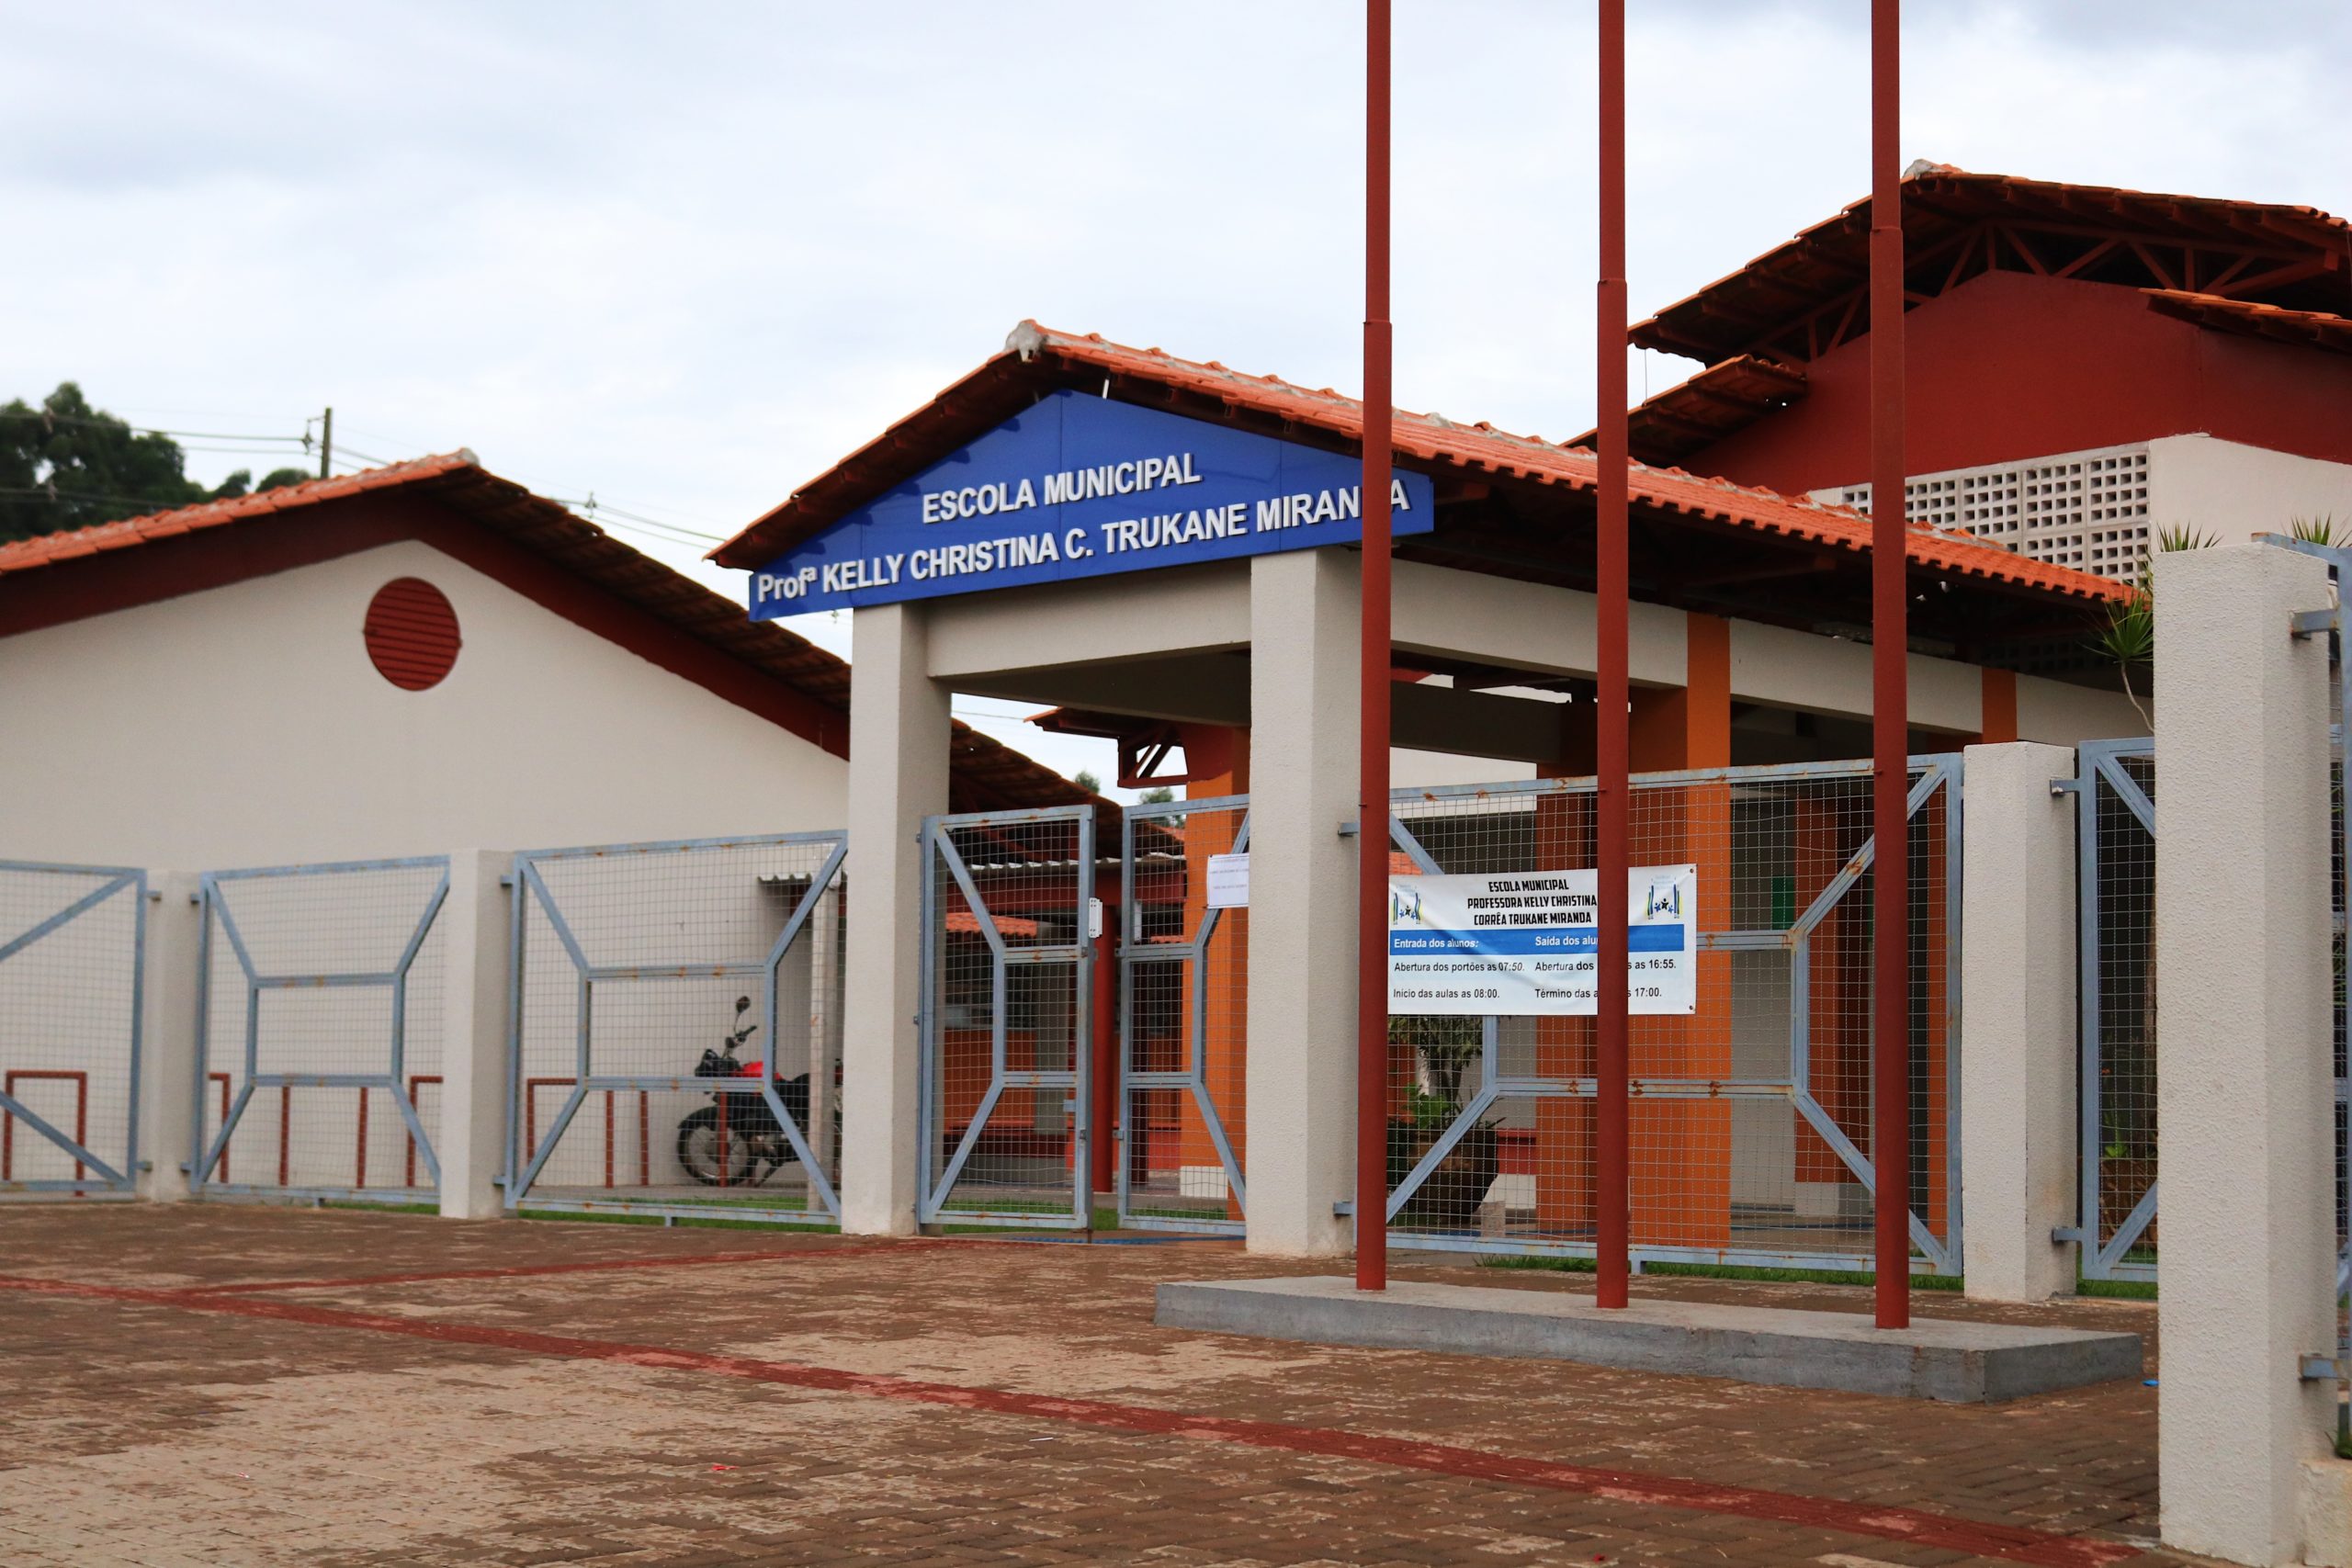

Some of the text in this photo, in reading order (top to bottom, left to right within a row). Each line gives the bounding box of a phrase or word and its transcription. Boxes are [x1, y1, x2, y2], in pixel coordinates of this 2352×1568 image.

[922, 453, 1202, 525] ESCOLA MUNICIPAL
[822, 553, 904, 593] KELLY
[910, 532, 1060, 581] CHRISTINA
[1065, 527, 1094, 560] C.
[1102, 502, 1248, 553] TRUKANE
[1256, 479, 1410, 533] MIRANA
[1488, 879, 1569, 892] ESCOLA MUNICIPAL
[1467, 895, 1598, 908] PROFESSORA KELLY CHRISTINA
[1474, 912, 1591, 925] CORRÊA TRUKANE MIRANDA
[1394, 938, 1479, 948] Entrada dos alunos:
[1535, 936, 1561, 946] Saída
[1563, 935, 1579, 945] dos
[1395, 962, 1430, 972] Abertura
[1432, 962, 1449, 972] dos
[1452, 962, 1485, 973] portões
[1535, 961, 1594, 971] Abertura dos
[1649, 959, 1677, 969] 16:55.
[1394, 988, 1500, 998] Início das aulas as 08:00.
[1535, 988, 1572, 998] Término
[1574, 988, 1590, 998] das
[1634, 987, 1662, 998] 17:00.
